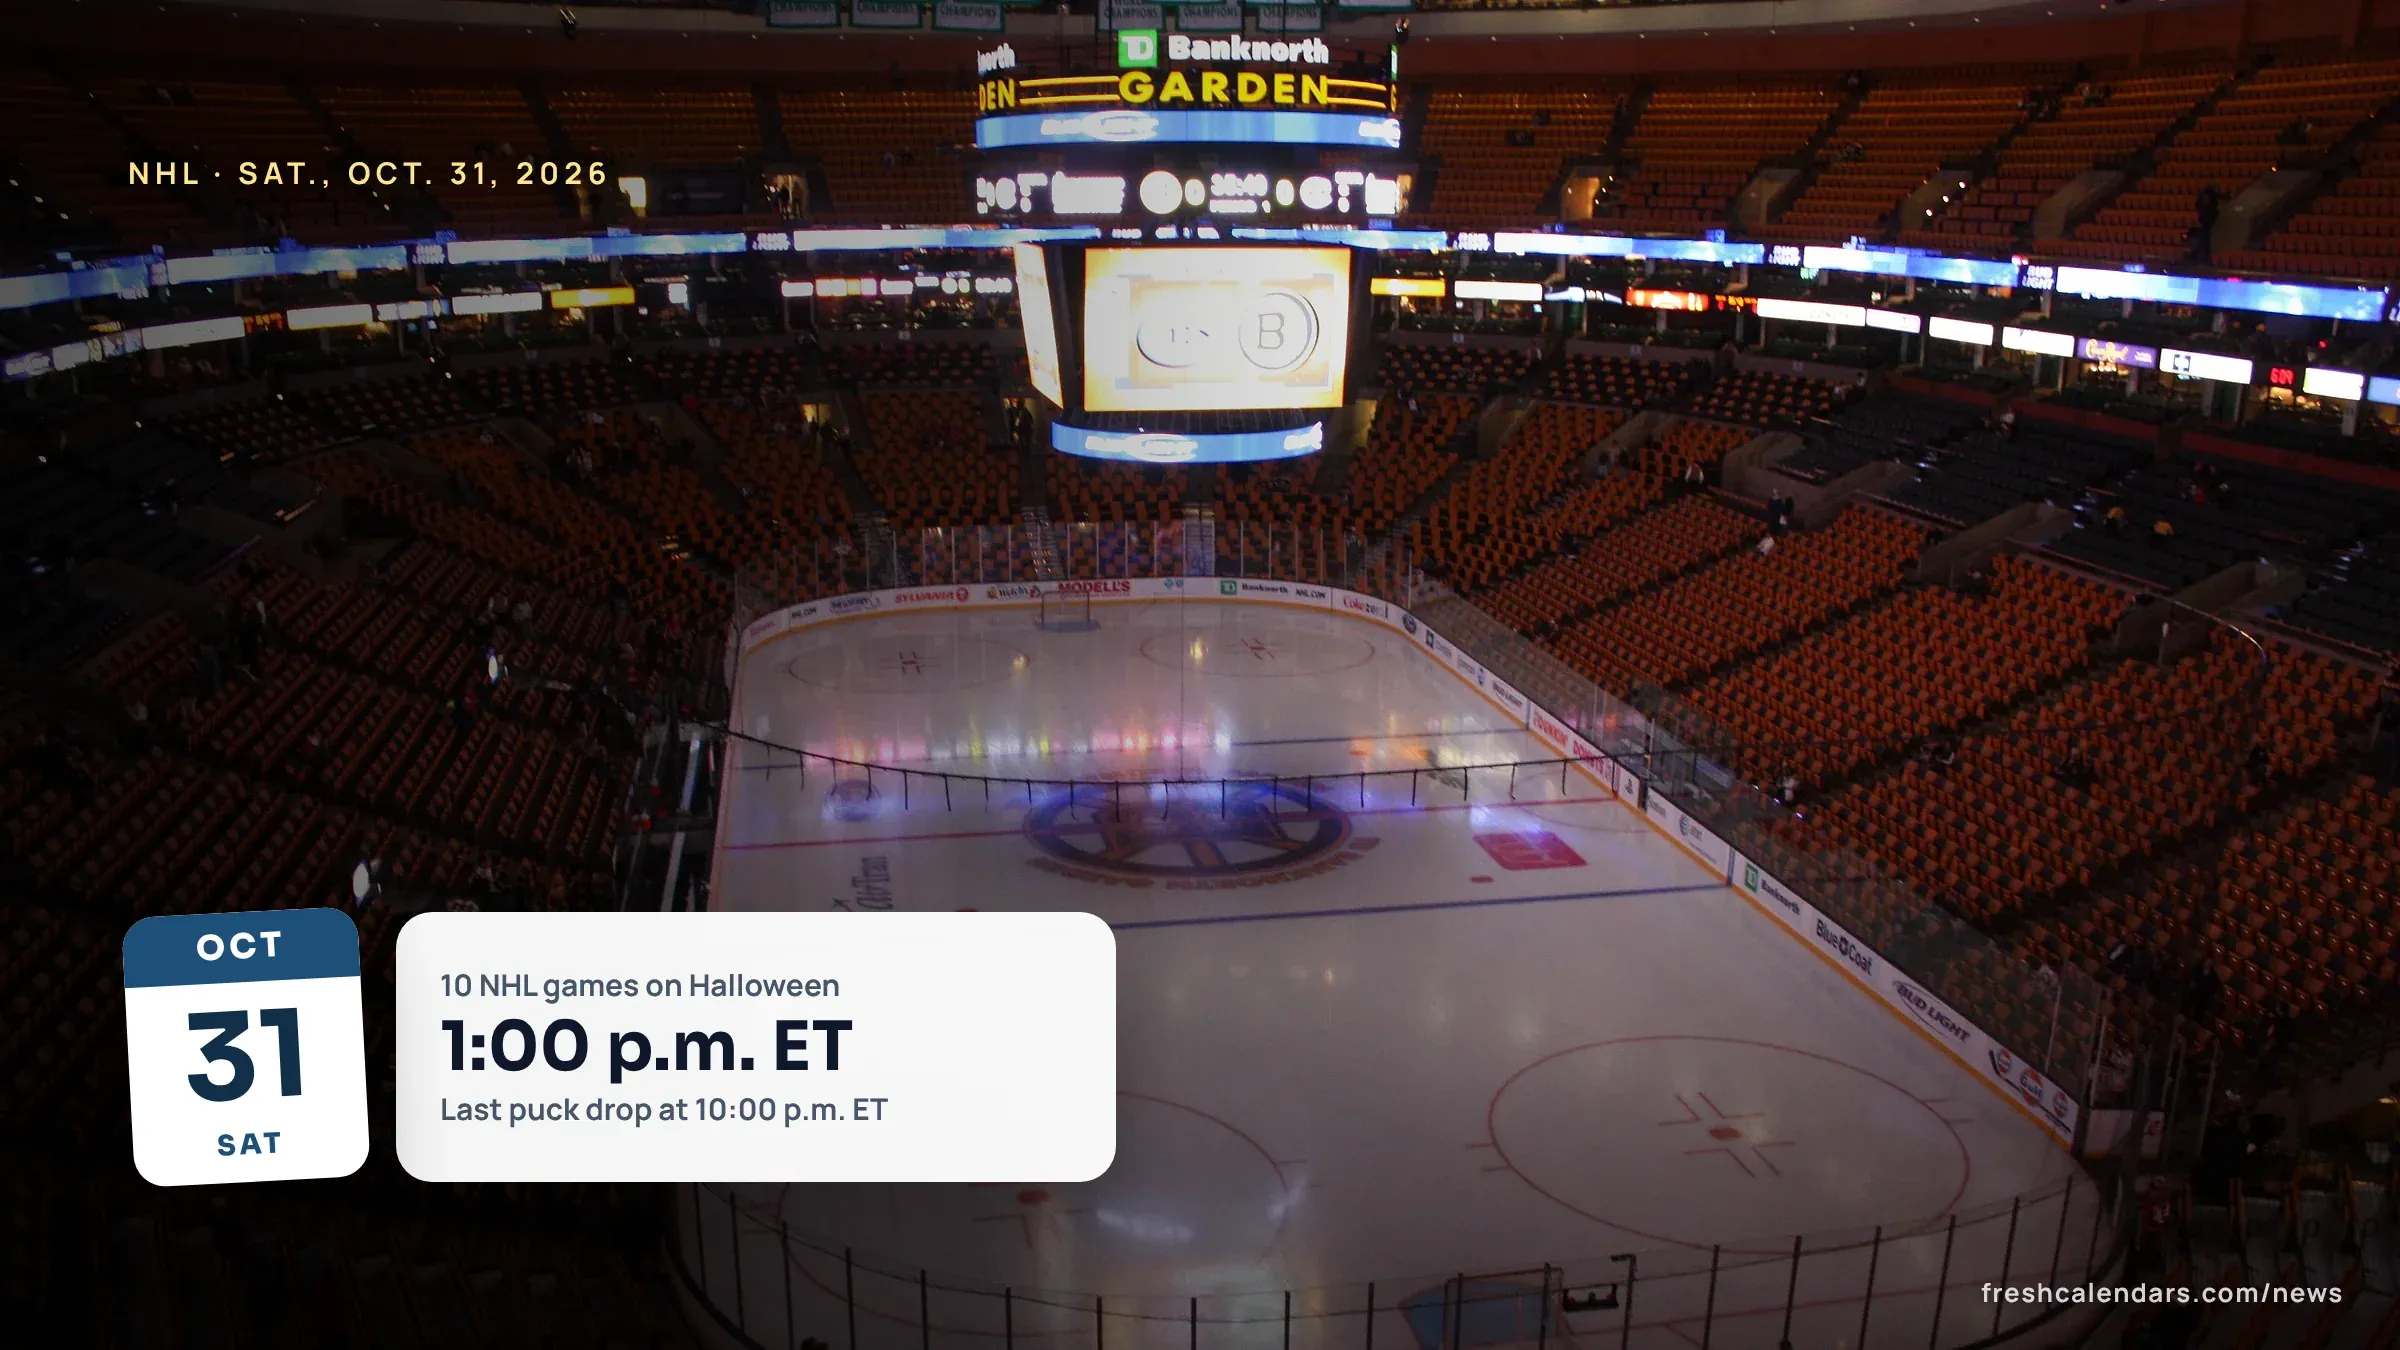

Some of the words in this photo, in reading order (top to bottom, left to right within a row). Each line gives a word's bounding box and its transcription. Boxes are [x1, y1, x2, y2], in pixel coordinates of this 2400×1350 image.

[977, 42, 1015, 73] north
[1121, 35, 1154, 61] TD
[1168, 34, 1329, 64] Banknorth
[1118, 71, 1328, 105] GARDEN
[1816, 917, 1839, 950] Blue
[1846, 940, 1873, 977] Coat
[1897, 983, 1928, 1010] BUD
[1926, 1005, 1972, 1045] LIGHT
